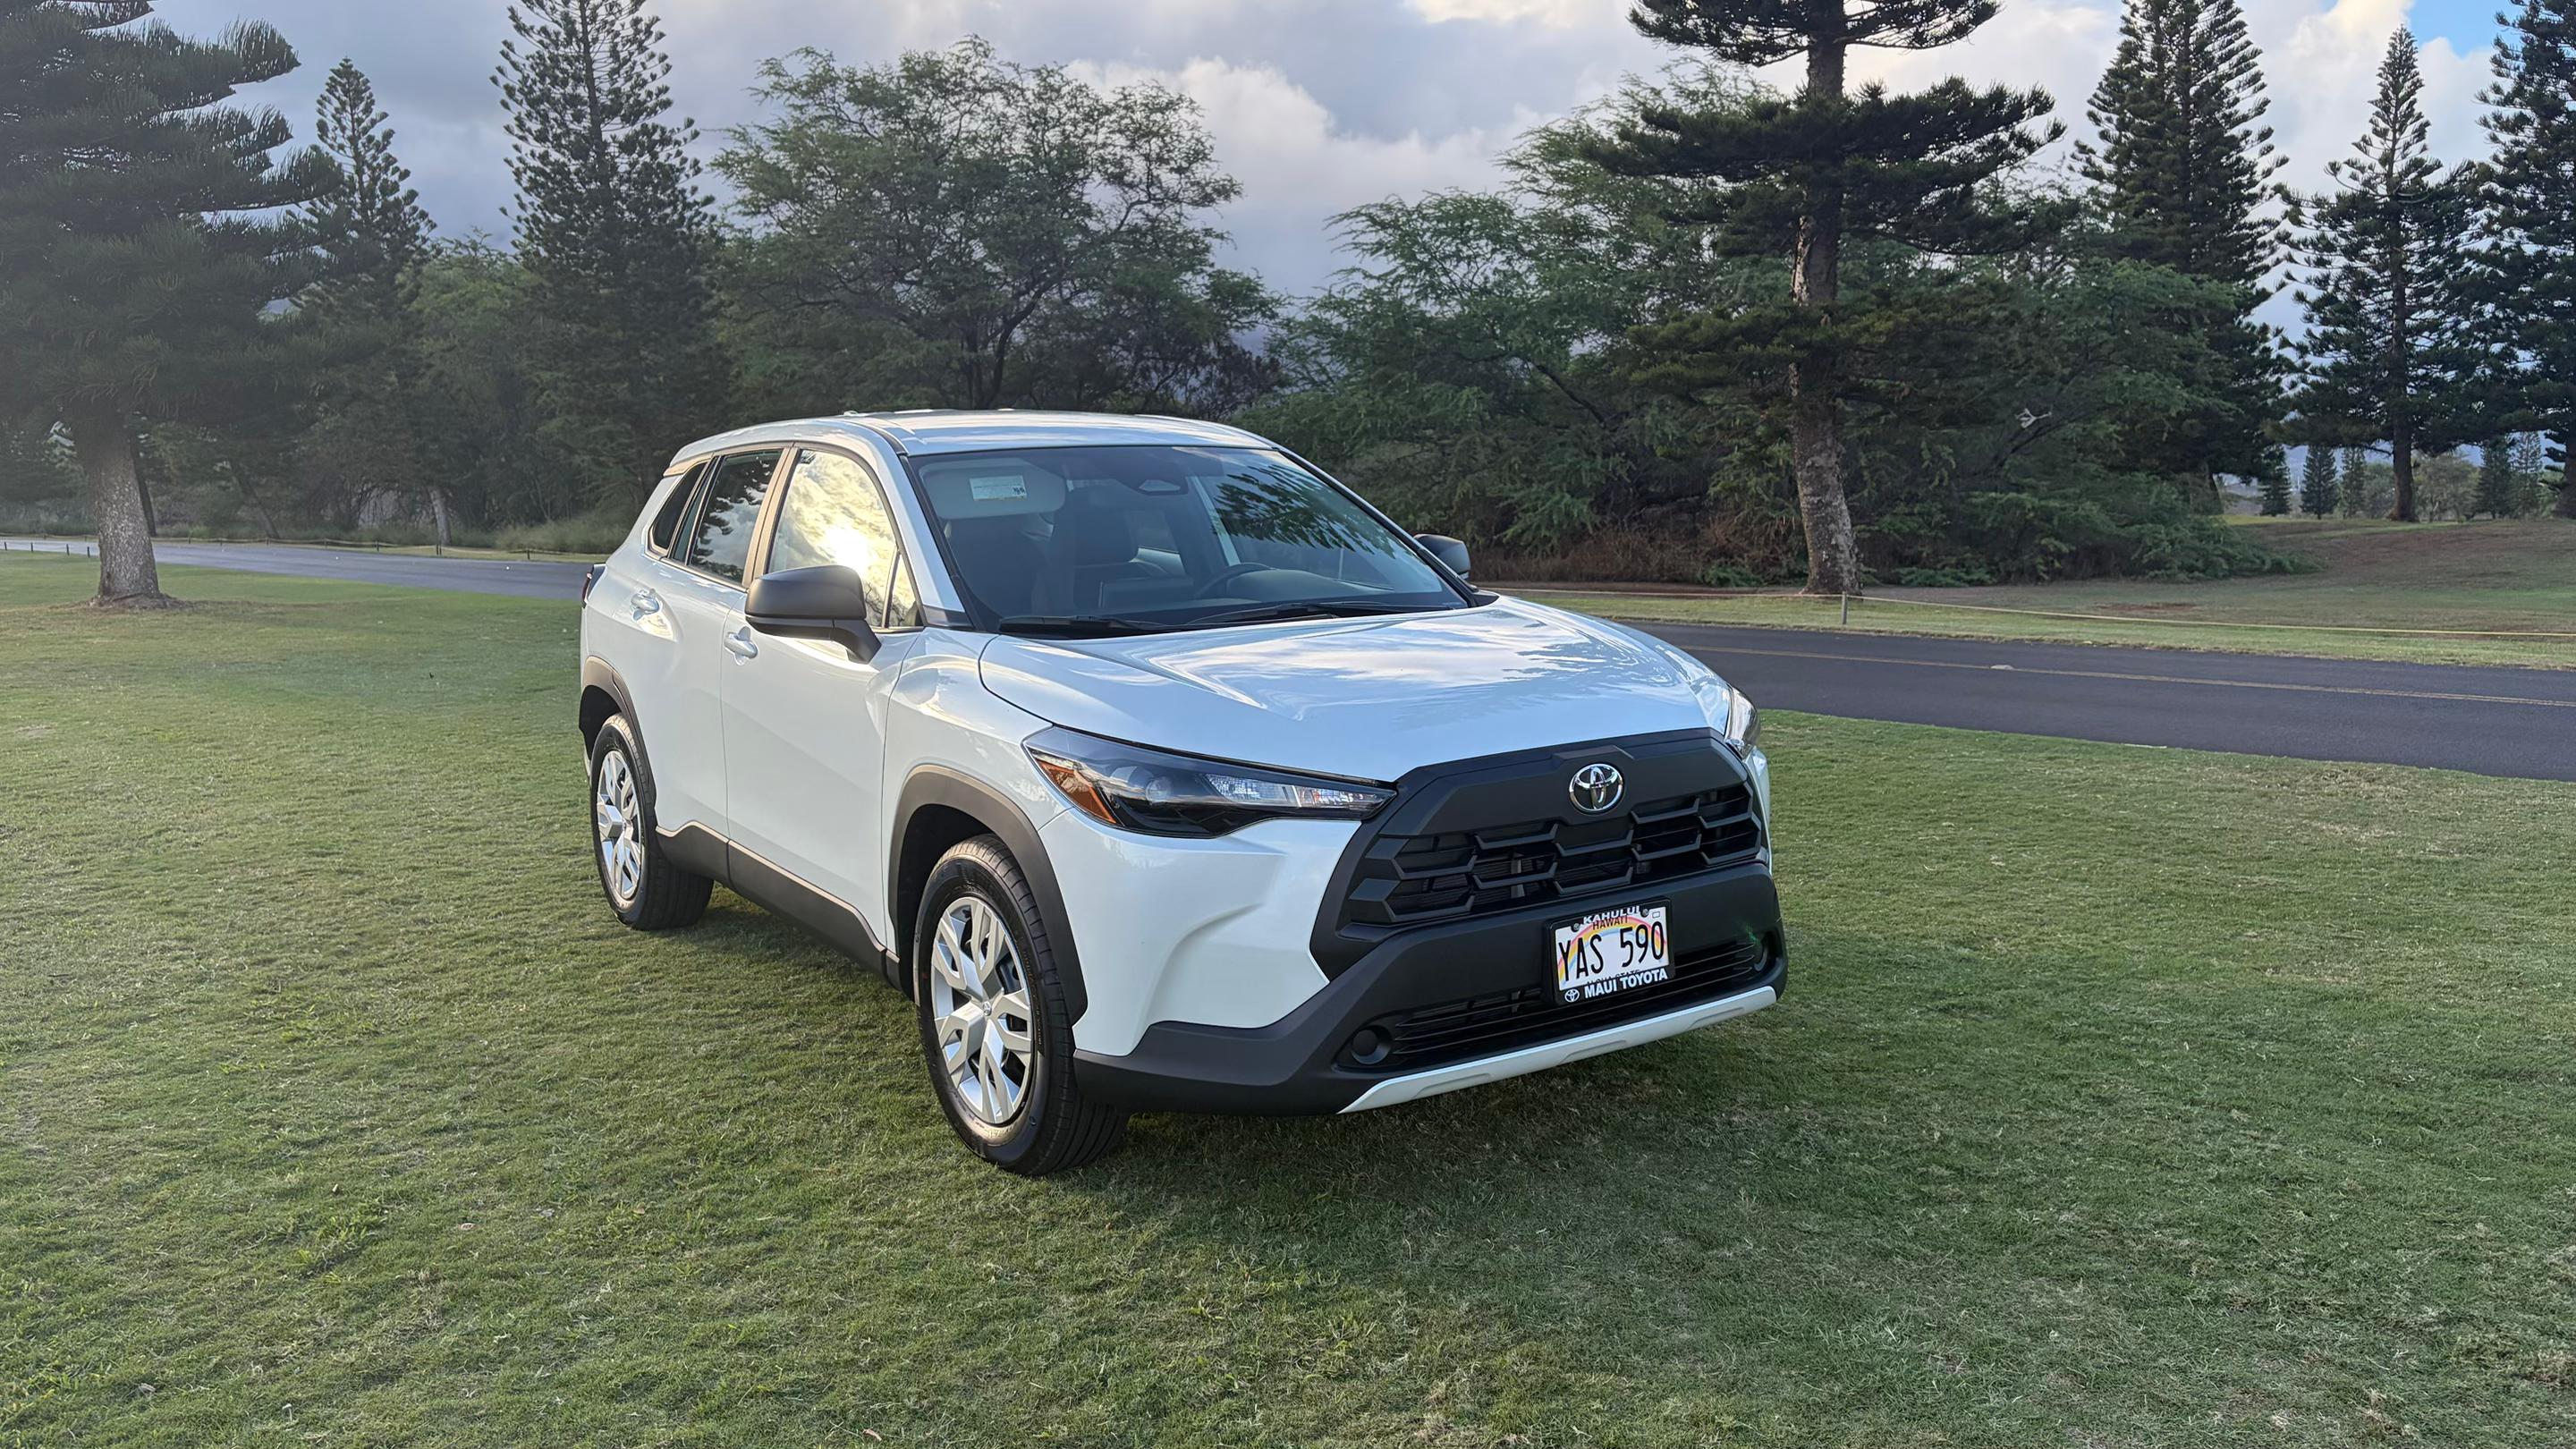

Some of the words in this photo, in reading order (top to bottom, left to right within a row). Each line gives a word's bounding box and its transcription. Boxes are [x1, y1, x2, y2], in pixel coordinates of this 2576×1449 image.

[1583, 905, 1640, 924] KAHULUI
[1592, 915, 1628, 930] HAWAII
[1558, 934, 1605, 982] YAS
[1620, 921, 1665, 968] 590
[1584, 979, 1618, 999] MAUI
[1620, 968, 1668, 989] TOYOTA
